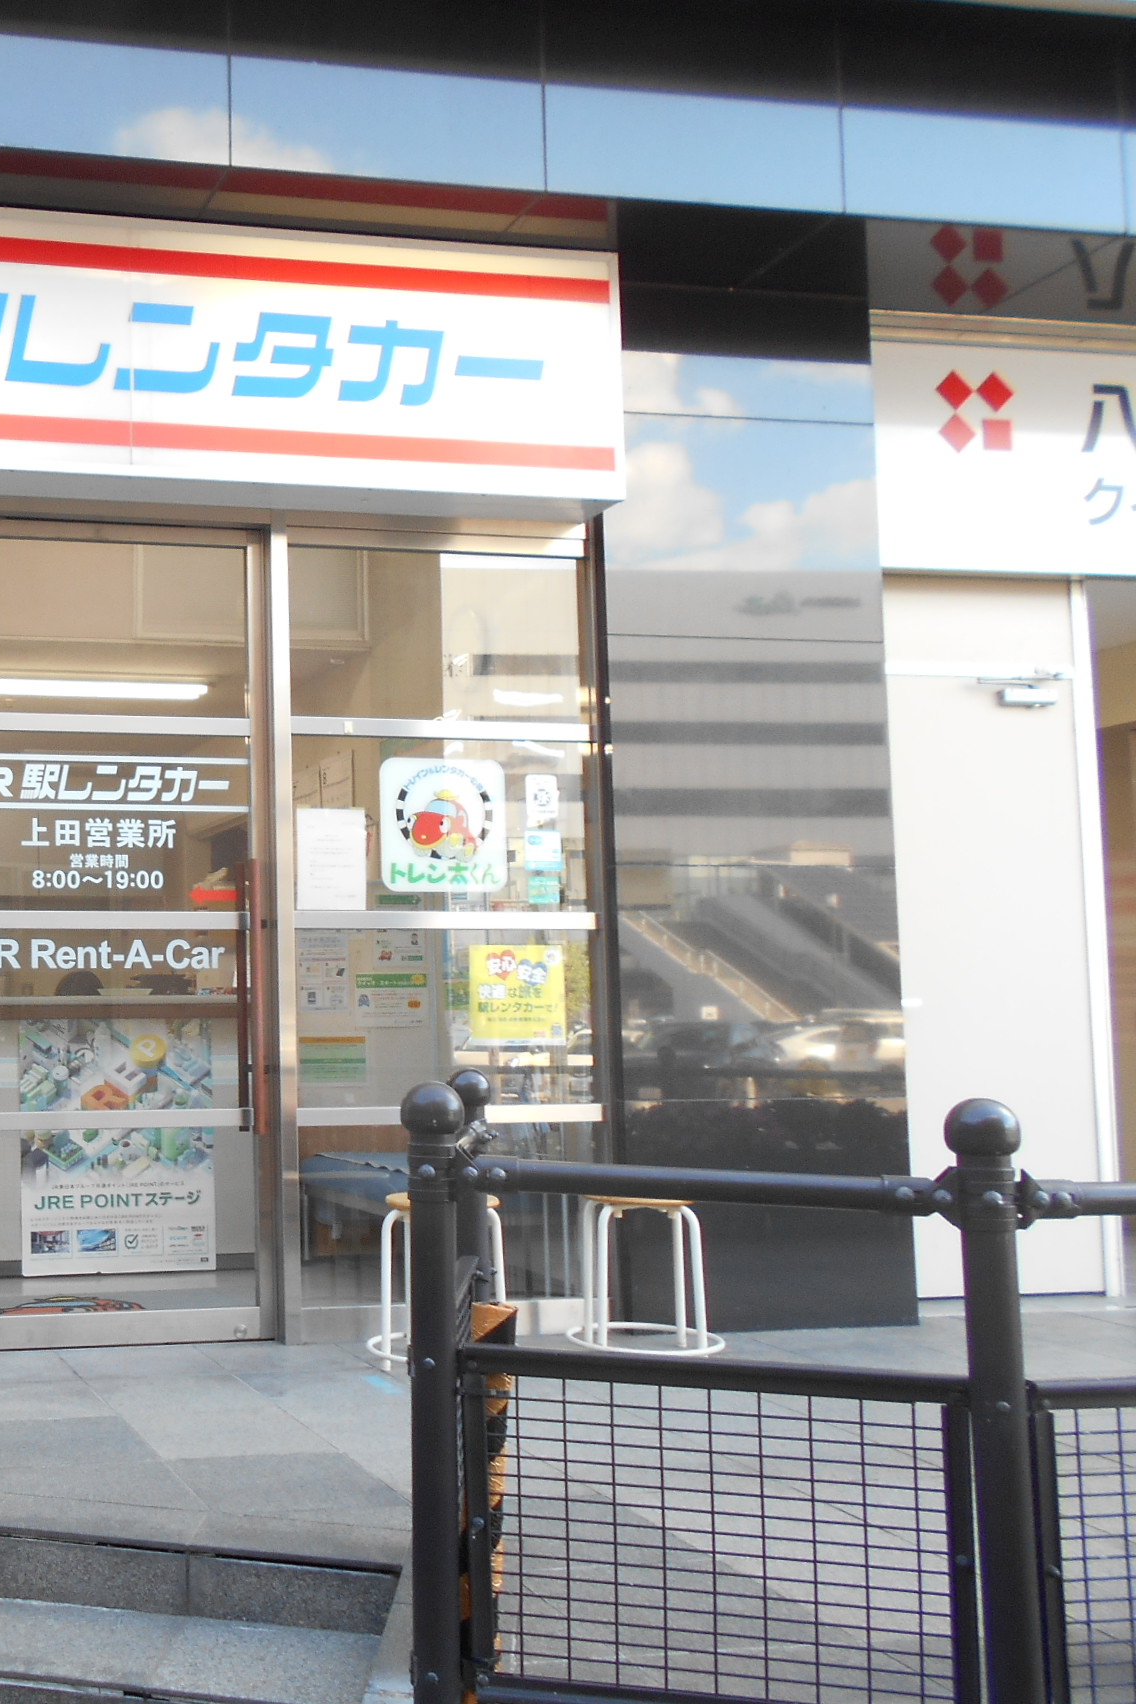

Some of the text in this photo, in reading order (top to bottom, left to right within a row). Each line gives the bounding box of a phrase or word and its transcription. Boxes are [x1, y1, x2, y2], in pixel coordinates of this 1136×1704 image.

[1084, 477, 1136, 525] ク
[21, 818, 177, 849] 上田営業所
[69, 853, 129, 868] 営業時間
[389, 862, 500, 886] トレン太くん
[31, 938, 225, 970] Rent-A-Car
[34, 1195, 74, 1210] JRE
